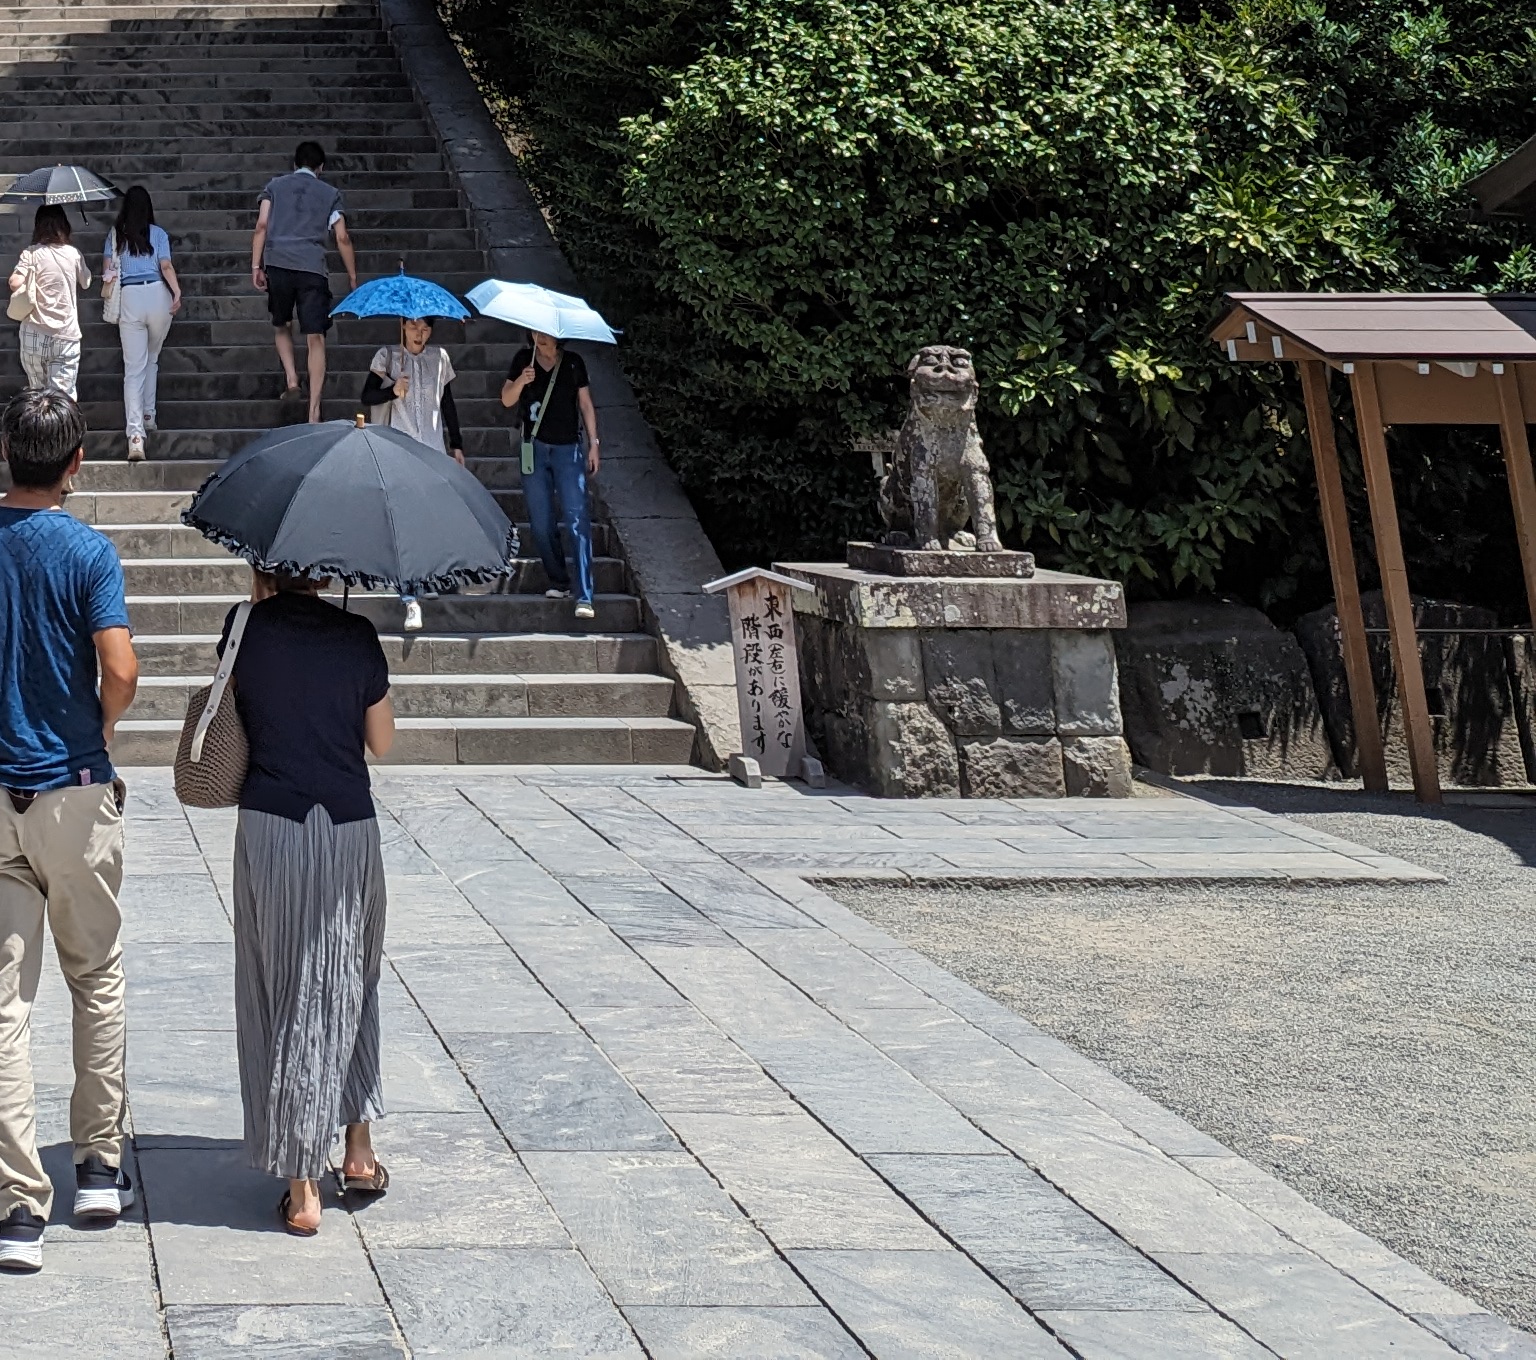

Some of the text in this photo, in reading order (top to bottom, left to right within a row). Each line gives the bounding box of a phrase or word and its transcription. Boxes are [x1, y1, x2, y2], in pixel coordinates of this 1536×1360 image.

[740, 613, 766, 755] 階段があります
